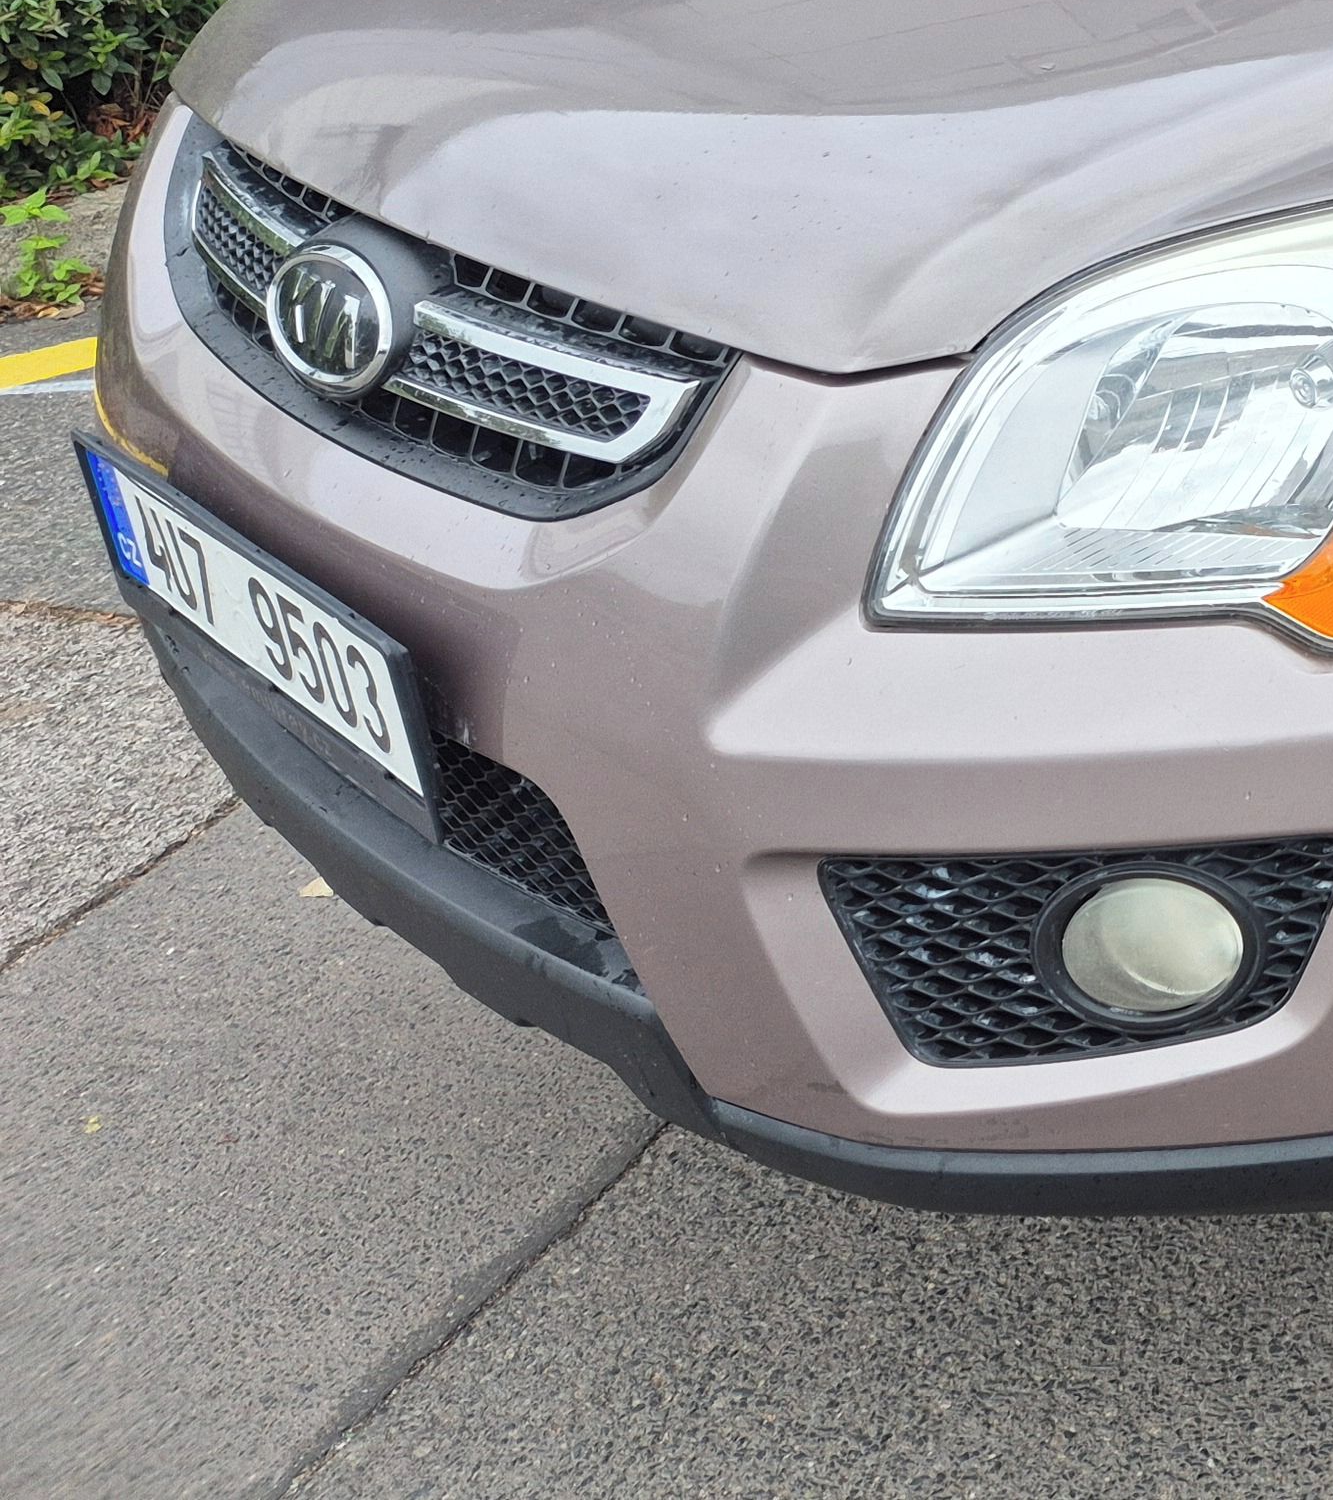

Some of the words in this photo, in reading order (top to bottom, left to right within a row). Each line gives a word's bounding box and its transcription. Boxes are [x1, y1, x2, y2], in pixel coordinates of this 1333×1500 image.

[117, 531, 143, 569] CZ
[134, 494, 216, 628] 4U7
[248, 576, 392, 755] 9503
